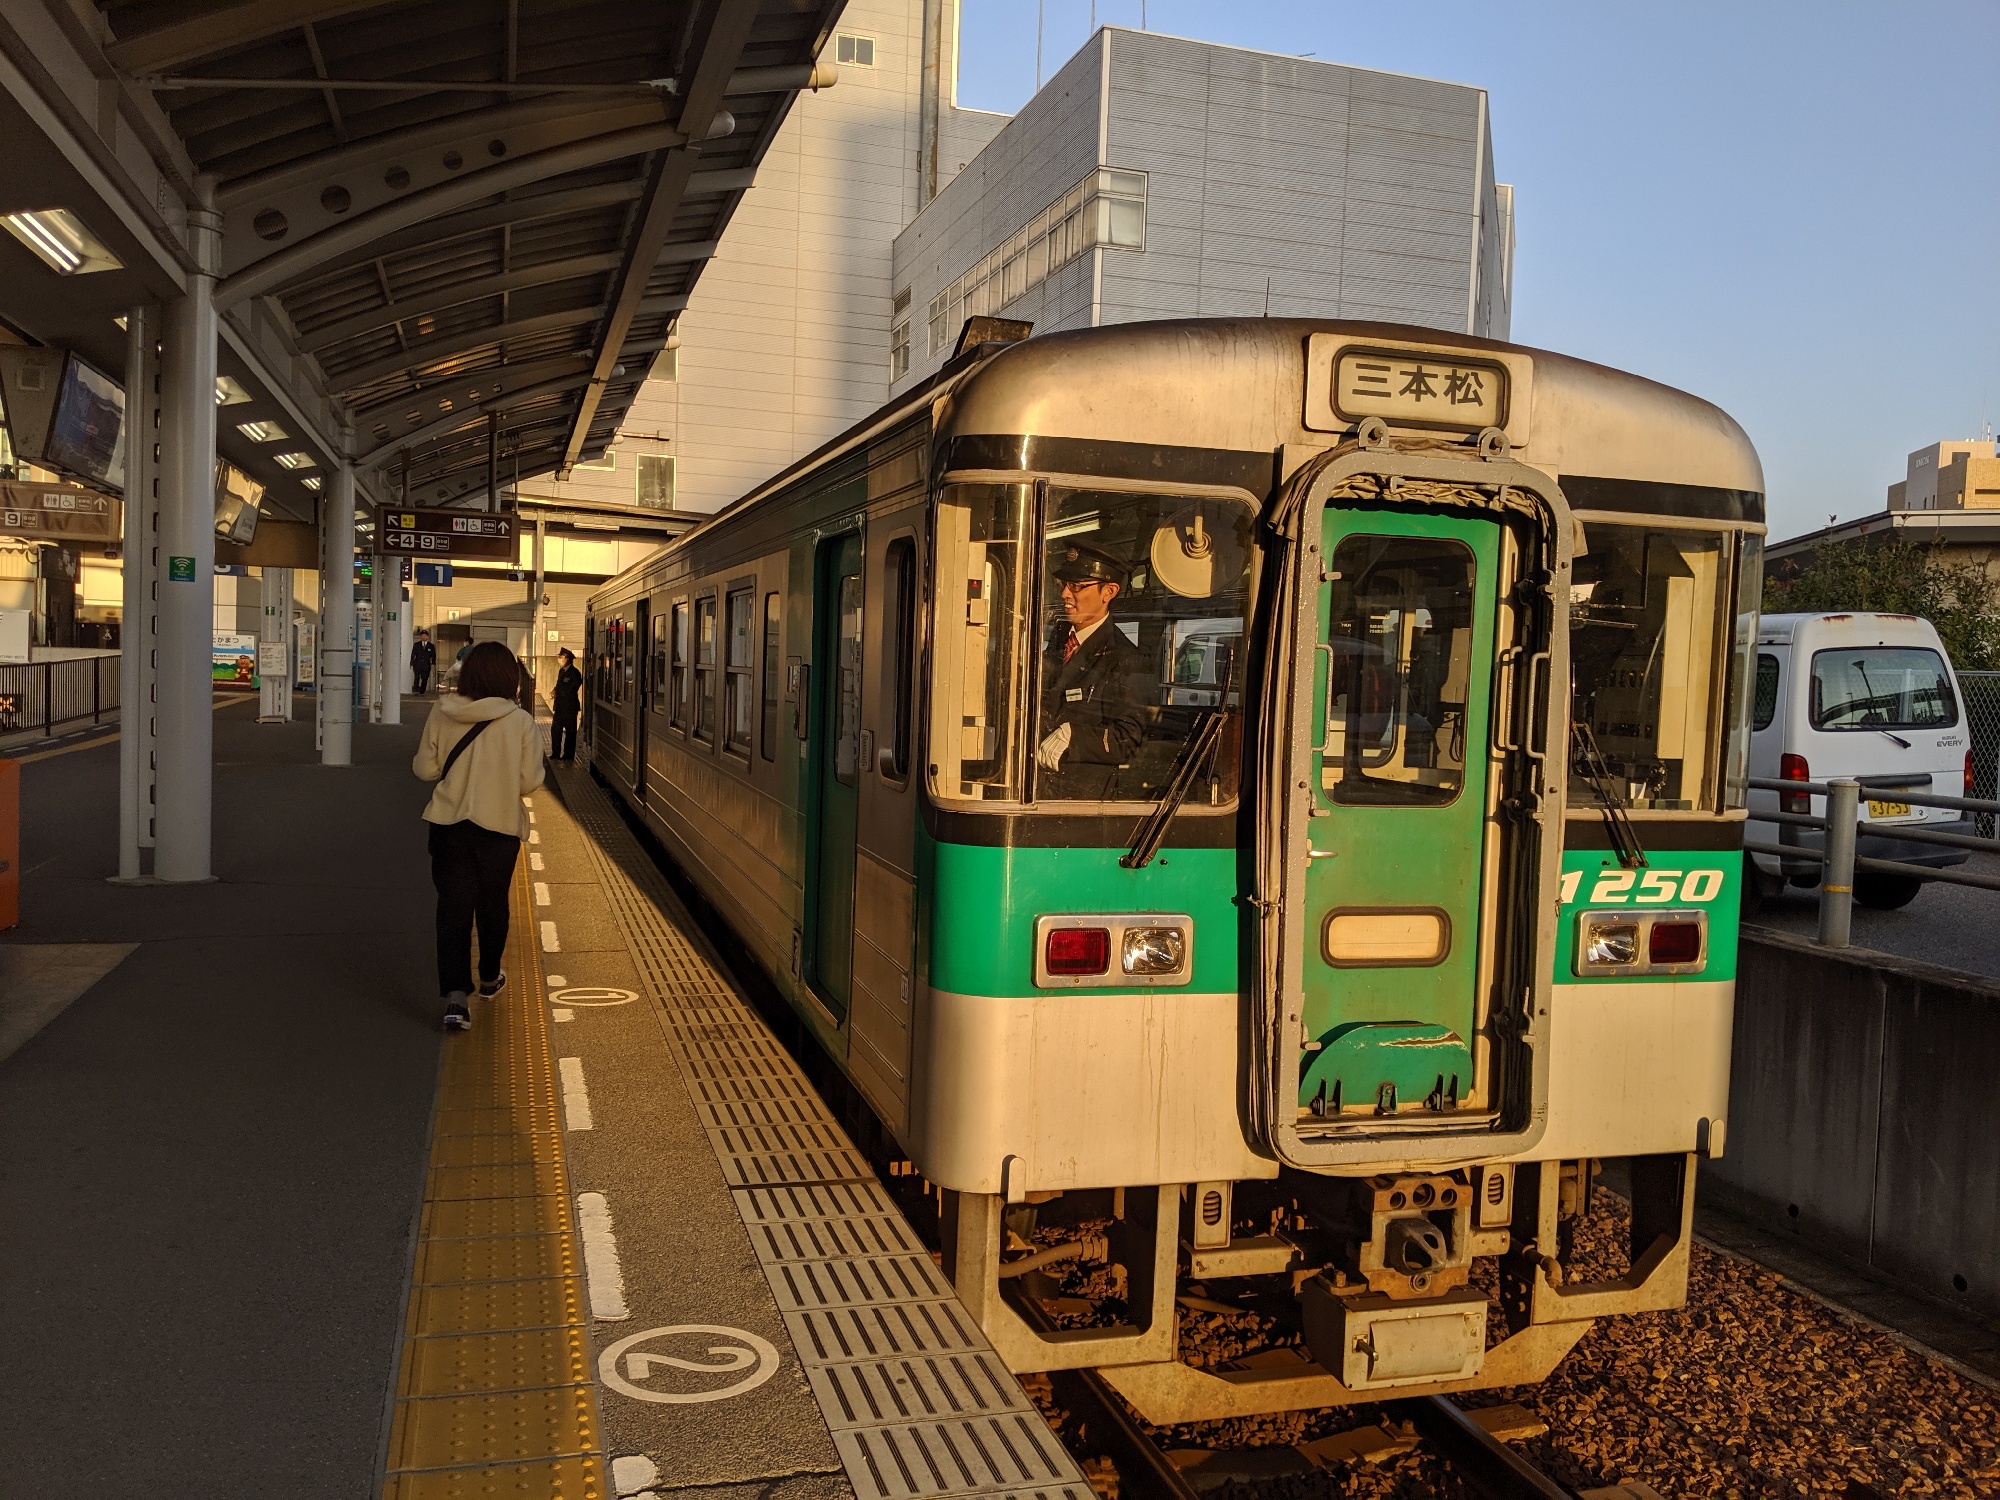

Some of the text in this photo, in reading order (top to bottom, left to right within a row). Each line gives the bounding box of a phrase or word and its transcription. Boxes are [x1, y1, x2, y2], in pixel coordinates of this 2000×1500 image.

[1352, 362, 1485, 408] 三本松
[435, 565, 444, 584] 1
[1936, 739, 1963, 747] EVERY
[1561, 869, 1725, 904] 1250
[625, 1346, 757, 1380] 2
